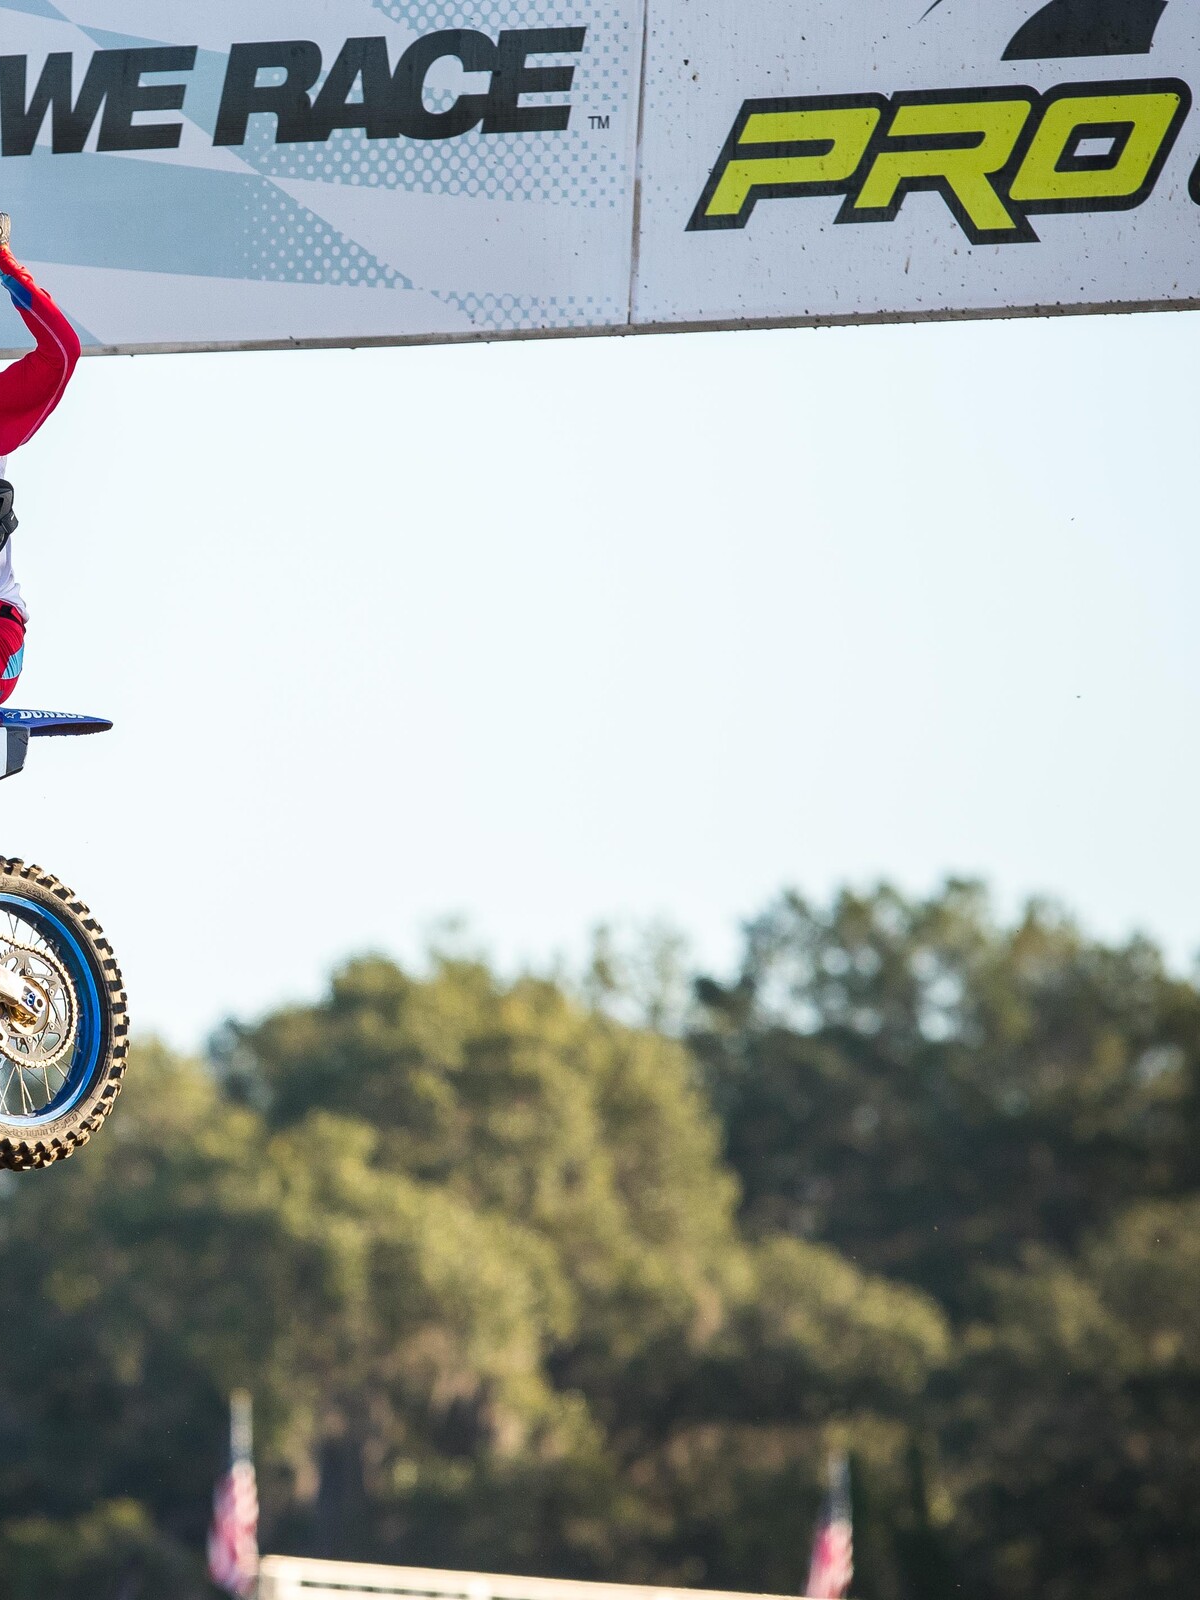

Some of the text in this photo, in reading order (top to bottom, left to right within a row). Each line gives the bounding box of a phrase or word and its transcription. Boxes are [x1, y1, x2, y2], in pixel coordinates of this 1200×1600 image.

[212, 26, 588, 147] RACE
[588, 115, 610, 130] TM
[685, 77, 1192, 245] PRO
[19, 709, 86, 720] DUNL
